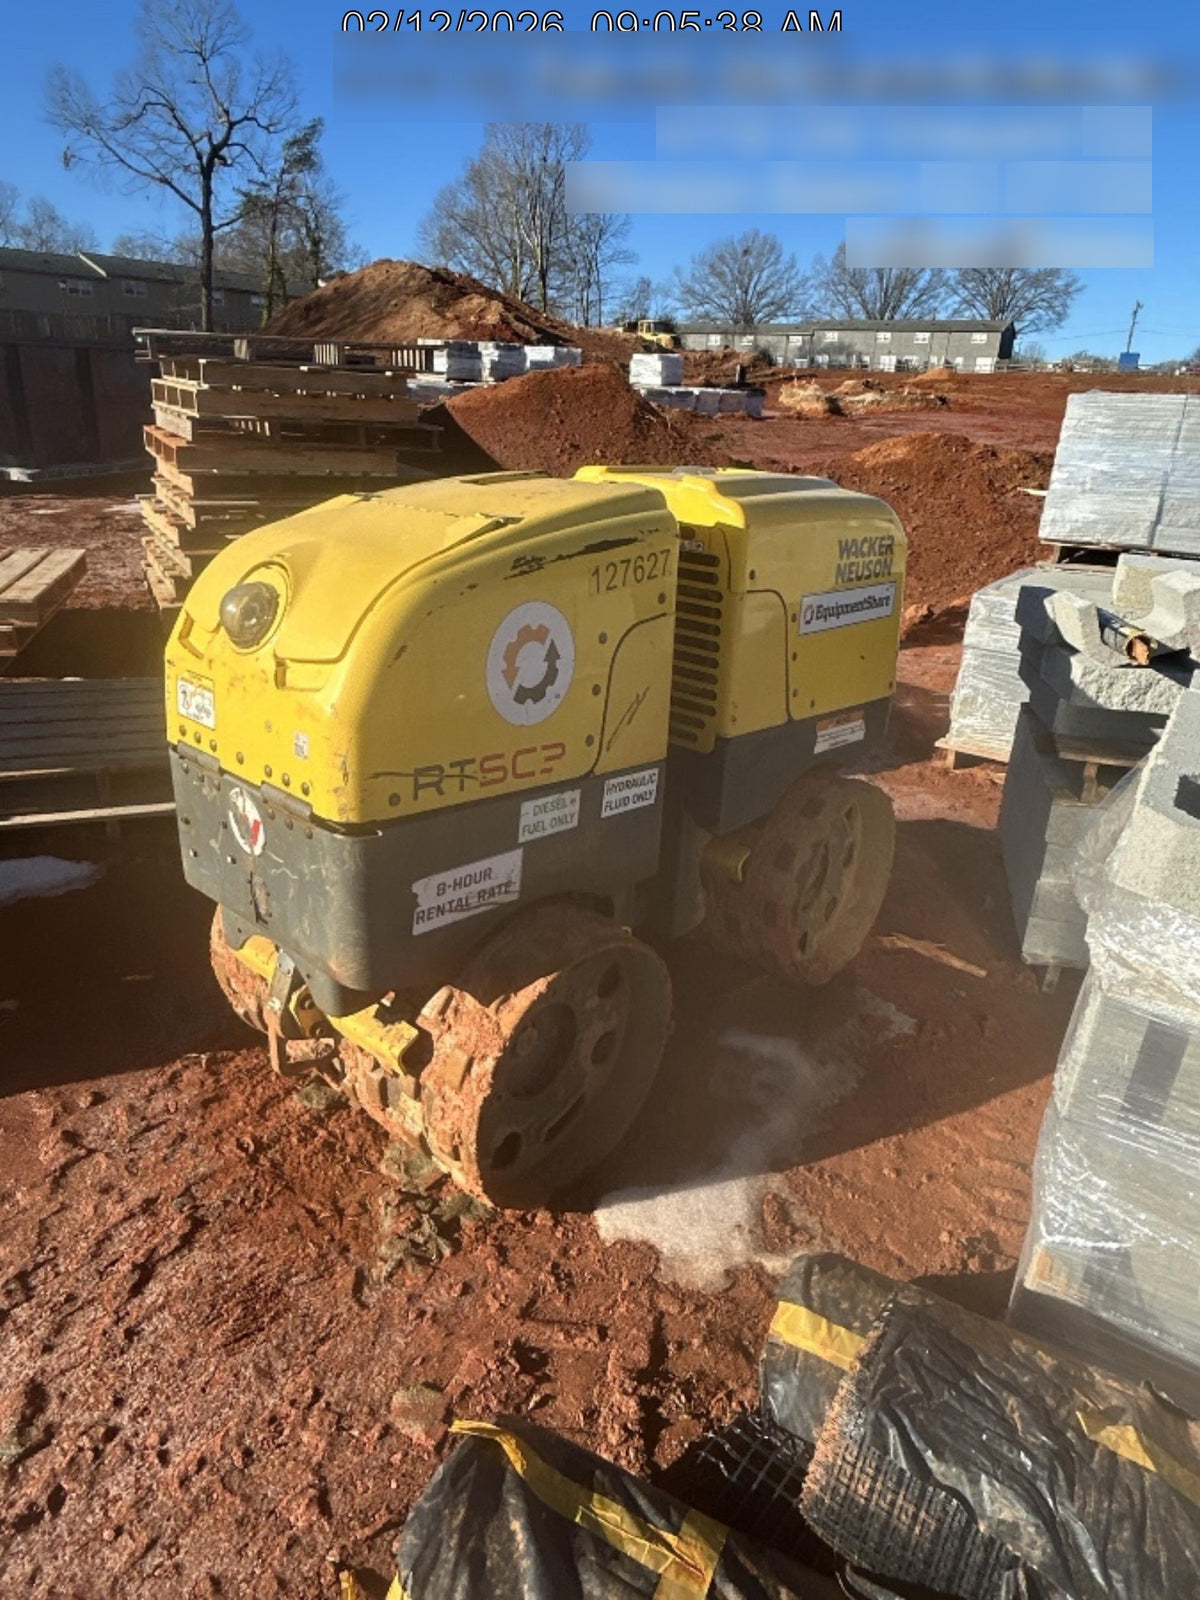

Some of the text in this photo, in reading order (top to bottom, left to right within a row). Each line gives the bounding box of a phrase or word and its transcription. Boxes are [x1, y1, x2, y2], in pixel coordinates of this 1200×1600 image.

[837, 534, 895, 560] WACKER
[592, 548, 671, 594] 127627
[835, 557, 893, 585] NEUSON
[815, 594, 891, 622] EquipmentShare
[606, 772, 657, 796] HYDRAULIC
[532, 798, 569, 817] DIESEL
[604, 788, 655, 813] FLUID ONLY
[522, 811, 577, 837] FUEL ONLY
[436, 867, 493, 897] 8-HOUR
[415, 880, 513, 925] RENTAL RATE
